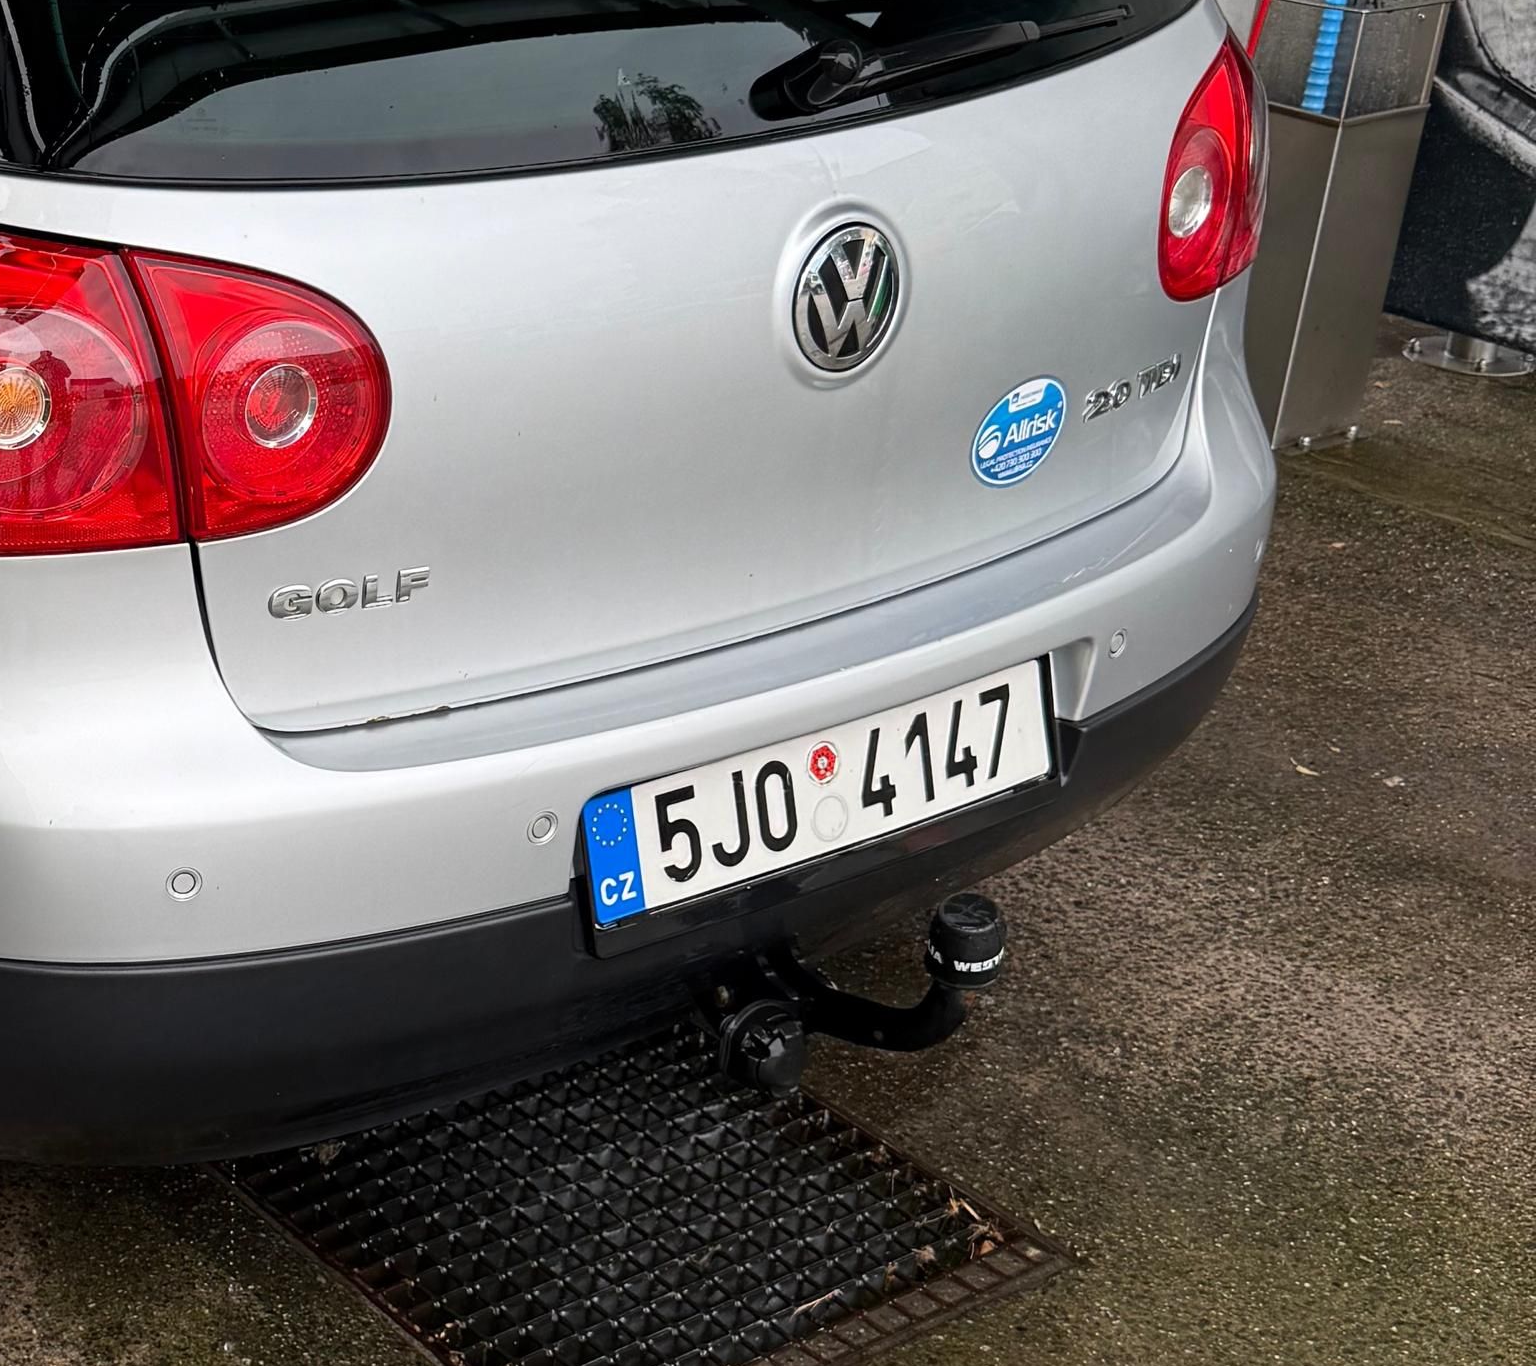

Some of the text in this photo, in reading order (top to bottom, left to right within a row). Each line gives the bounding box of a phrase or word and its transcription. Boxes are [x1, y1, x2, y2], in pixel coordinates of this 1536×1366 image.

[1003, 409, 1059, 448] Allrisk
[267, 565, 431, 621] GOLF
[861, 683, 1011, 817] 4147
[599, 871, 638, 907] CZ
